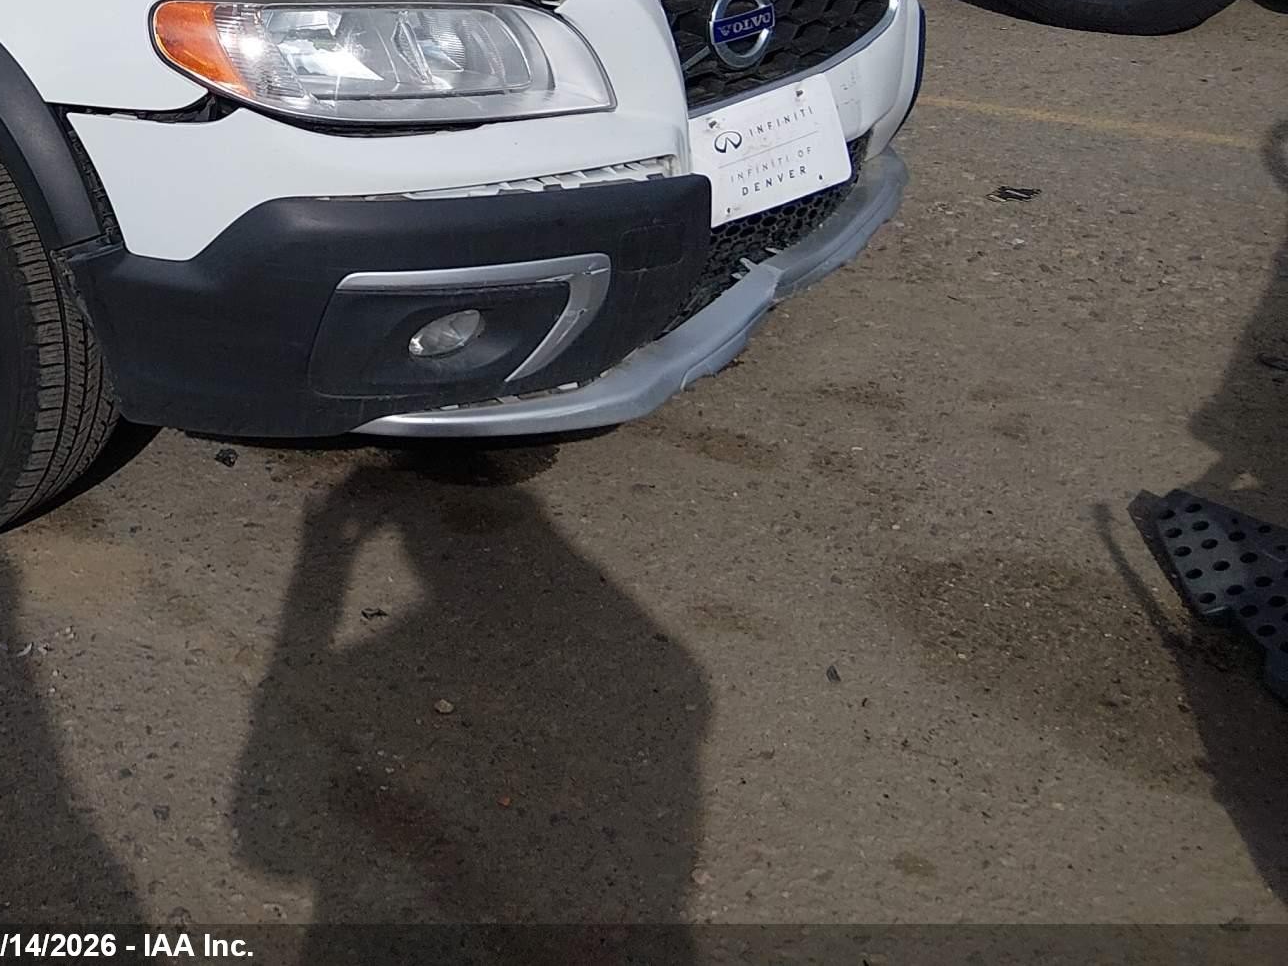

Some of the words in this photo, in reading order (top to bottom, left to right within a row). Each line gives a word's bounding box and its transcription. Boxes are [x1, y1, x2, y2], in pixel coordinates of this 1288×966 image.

[717, 12, 772, 36] VOLVO
[749, 106, 813, 136] INFINITI
[730, 155, 790, 183] INFINITI
[797, 146, 811, 158] OF
[742, 166, 807, 196] DENVER
